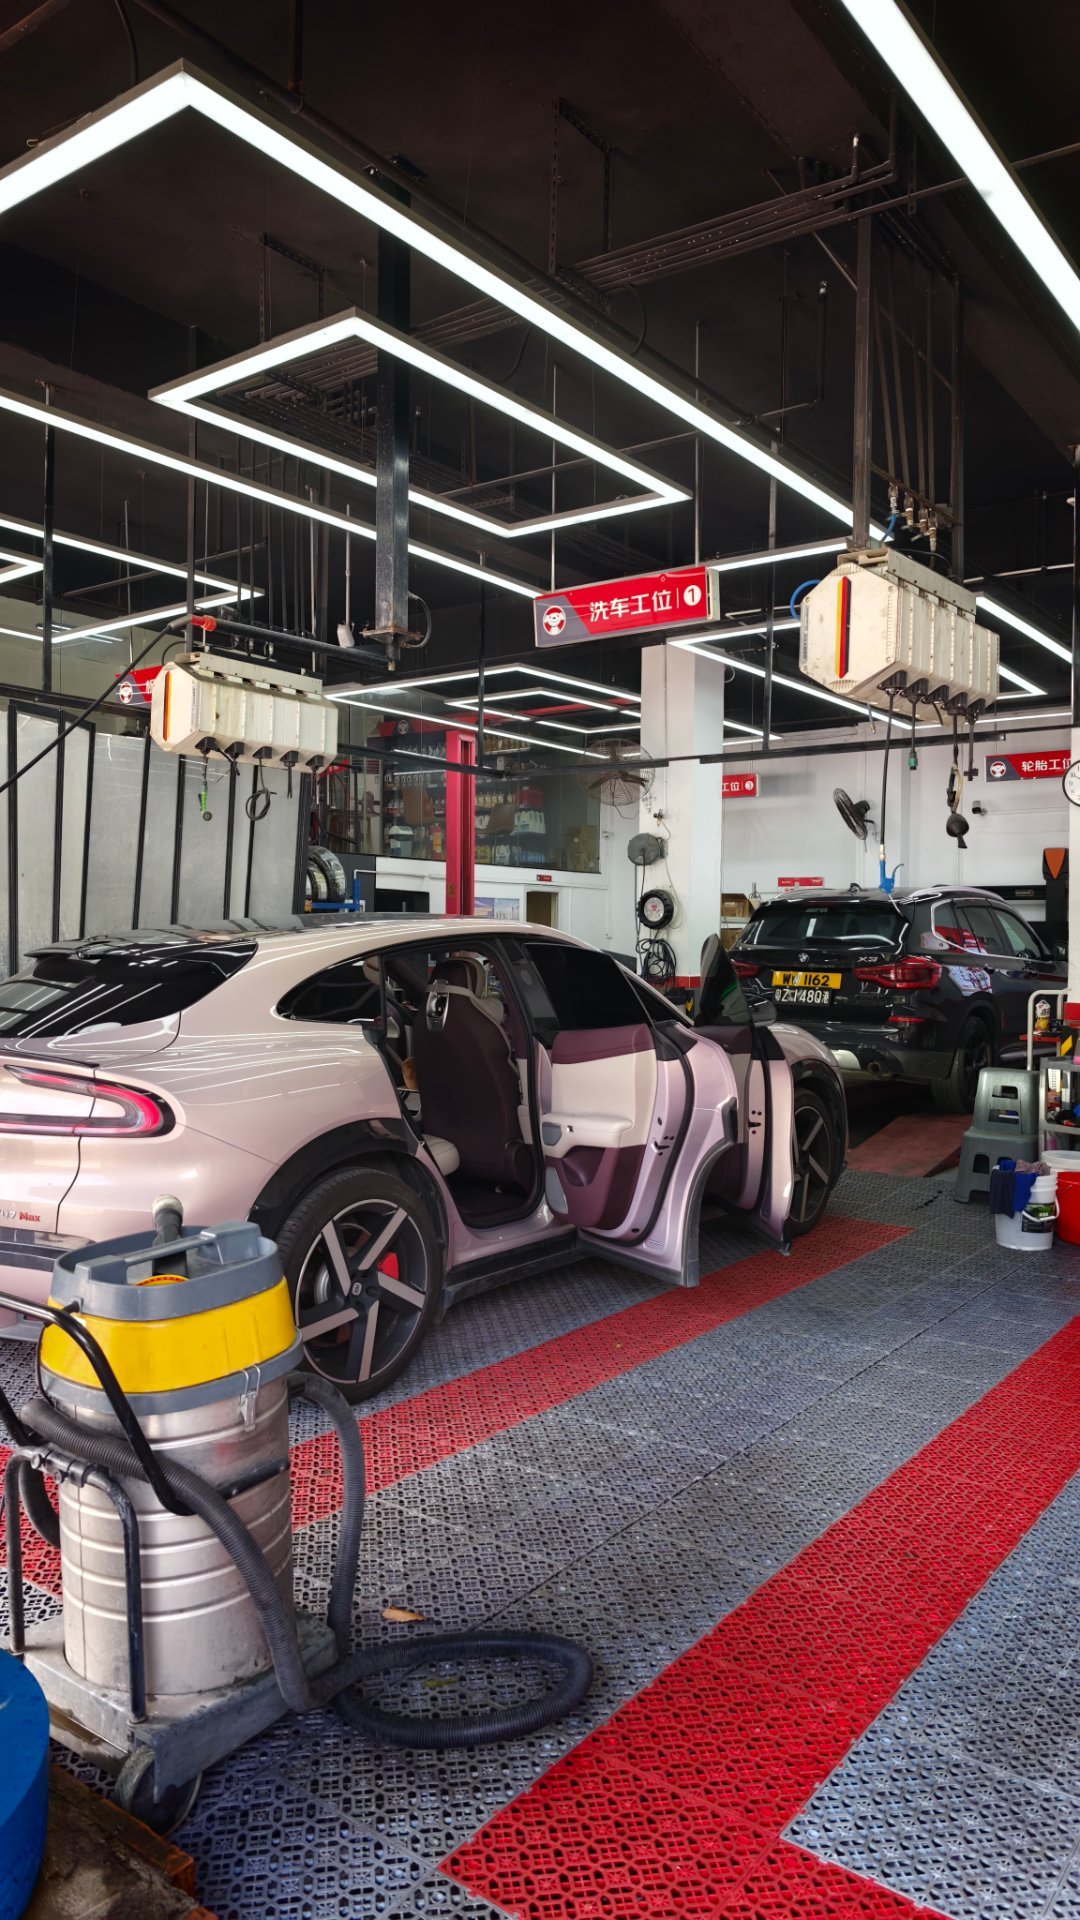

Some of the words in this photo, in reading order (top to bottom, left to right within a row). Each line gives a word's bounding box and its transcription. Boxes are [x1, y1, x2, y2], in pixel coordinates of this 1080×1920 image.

[589, 590, 672, 622] 洗车工位
[803, 974, 830, 986] 1162
[19, 1211, 41, 1221] Max
